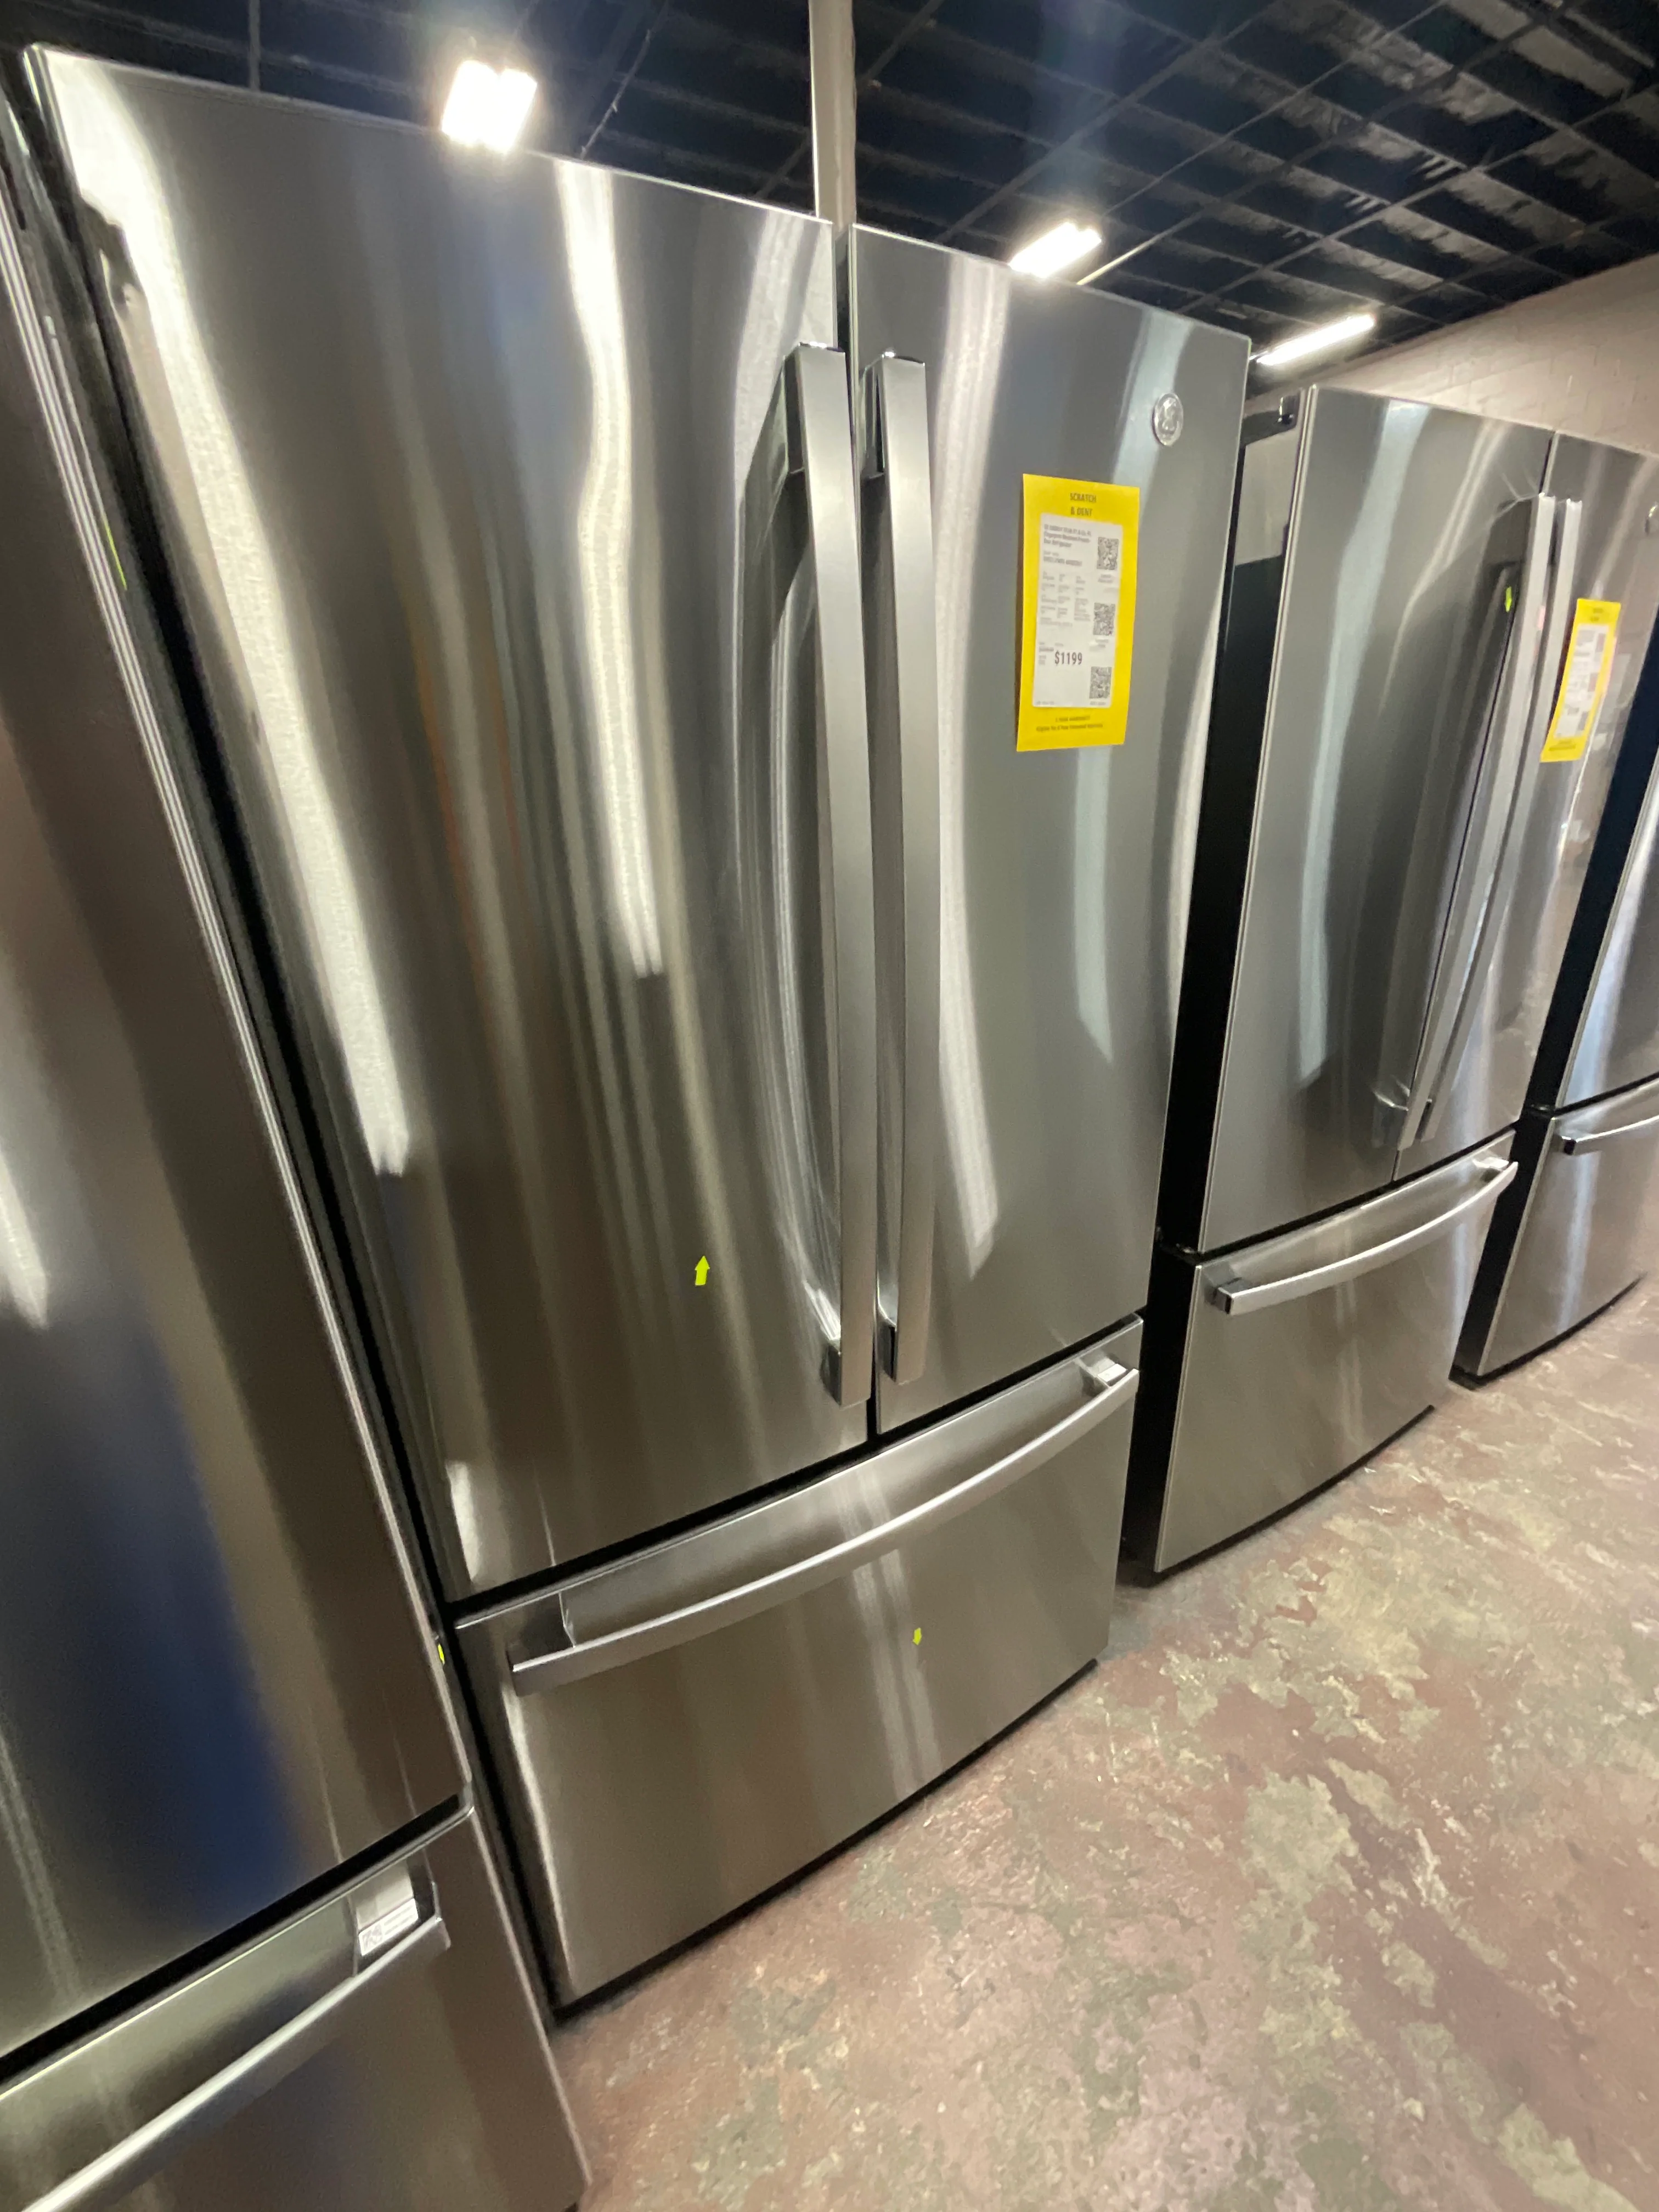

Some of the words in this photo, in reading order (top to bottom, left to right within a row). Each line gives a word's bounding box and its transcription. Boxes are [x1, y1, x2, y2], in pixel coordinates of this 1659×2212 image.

[1070, 493, 1096, 503] SCRATCH
[1077, 507, 1093, 516] DENT
[1054, 650, 1083, 665] $1199
